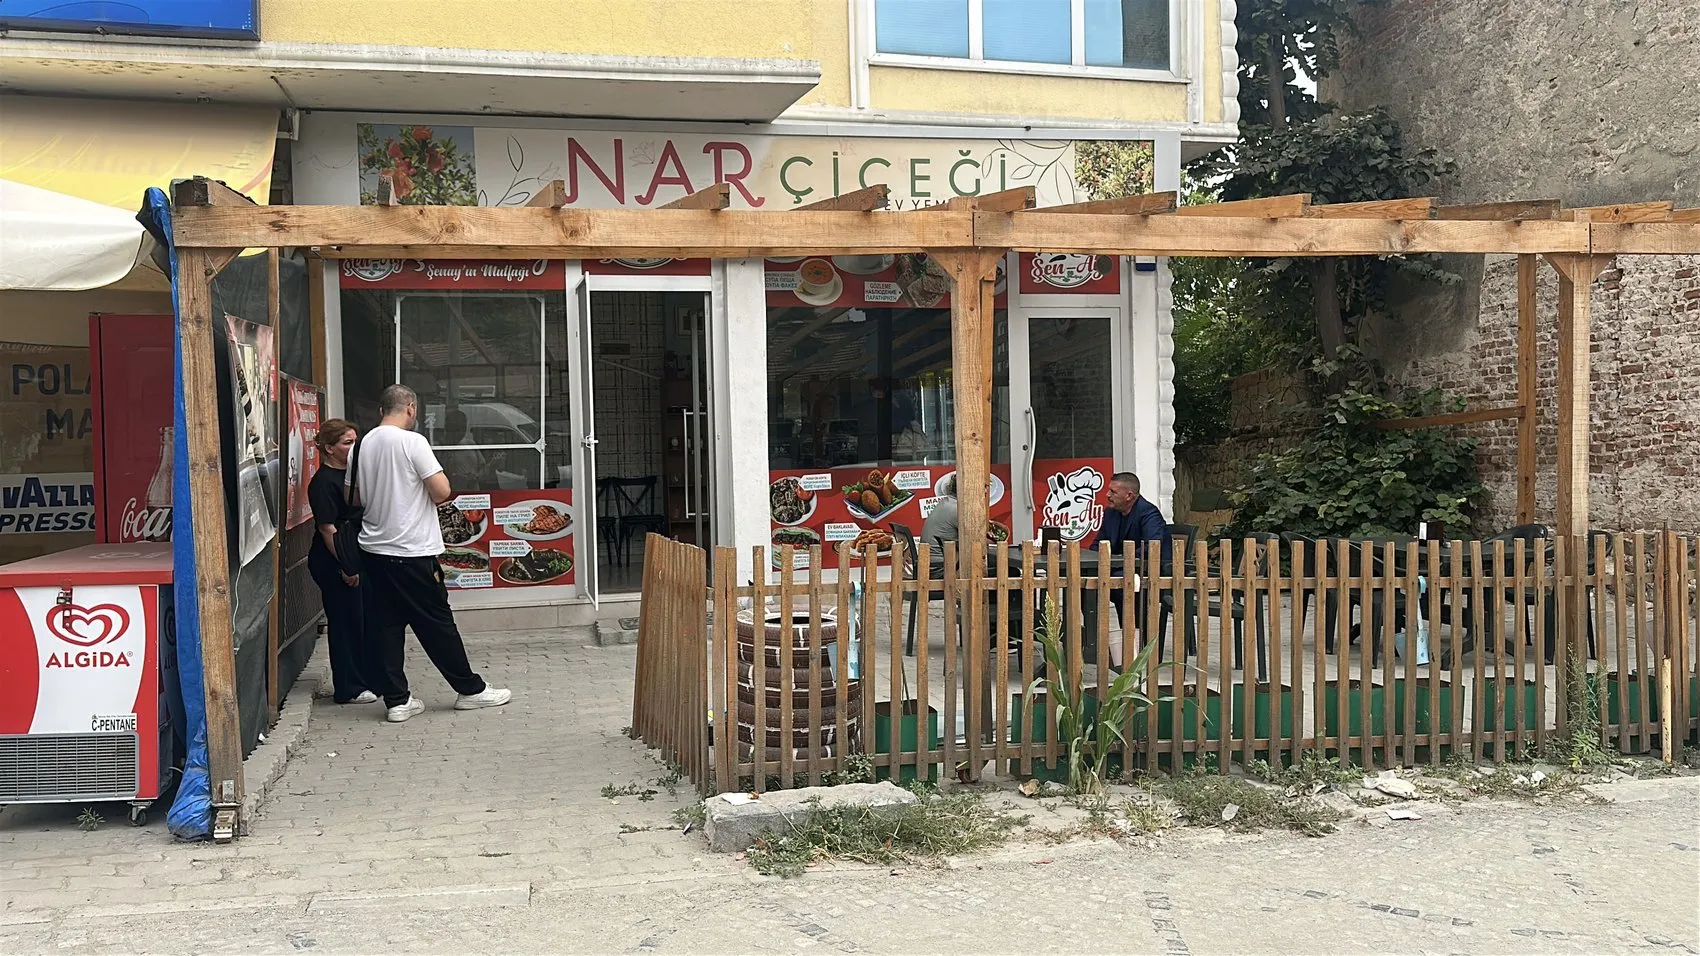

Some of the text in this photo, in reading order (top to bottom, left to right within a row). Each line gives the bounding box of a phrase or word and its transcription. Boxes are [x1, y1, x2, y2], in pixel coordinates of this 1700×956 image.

[565, 137, 765, 207] NAR
[884, 199, 904, 211] EV
[13, 364, 92, 395] POL
[0, 477, 94, 508] VAZZA
[120, 497, 171, 543] Coca
[91, 719, 136, 731] C-PENTANE
